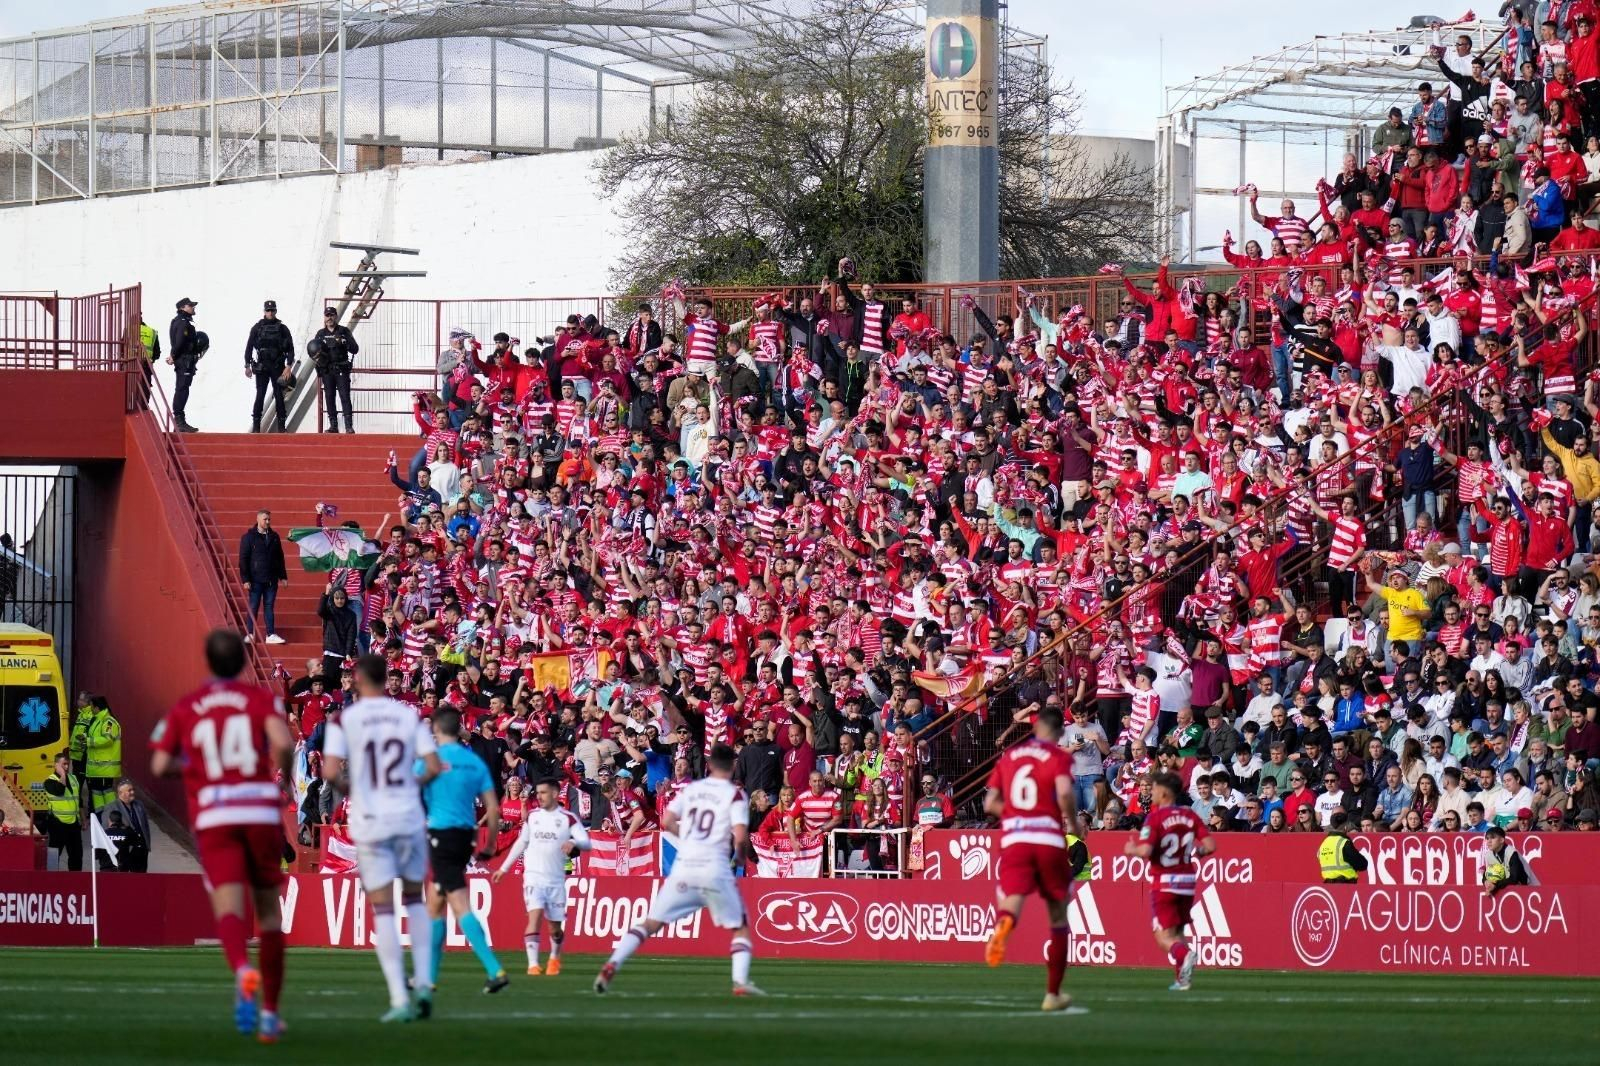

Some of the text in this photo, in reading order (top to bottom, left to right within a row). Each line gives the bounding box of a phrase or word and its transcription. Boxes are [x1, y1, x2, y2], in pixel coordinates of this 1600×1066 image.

[967, 125, 990, 138] 965
[1, 659, 37, 669] LANCIA
[191, 713, 258, 780] 14
[365, 738, 405, 789] 12
[1010, 764, 1038, 811] 6
[685, 807, 715, 841] 19
[1160, 831, 1196, 867] 21
[67, 893, 94, 925] S.L.
[765, 899, 853, 934] CRA
[865, 901, 998, 942] CONREALBA
[1344, 889, 1568, 934] AGUDO ROSA
[1308, 933, 1322, 944] 1947
[1380, 939, 1530, 967] CLÍNICA DENTAL
